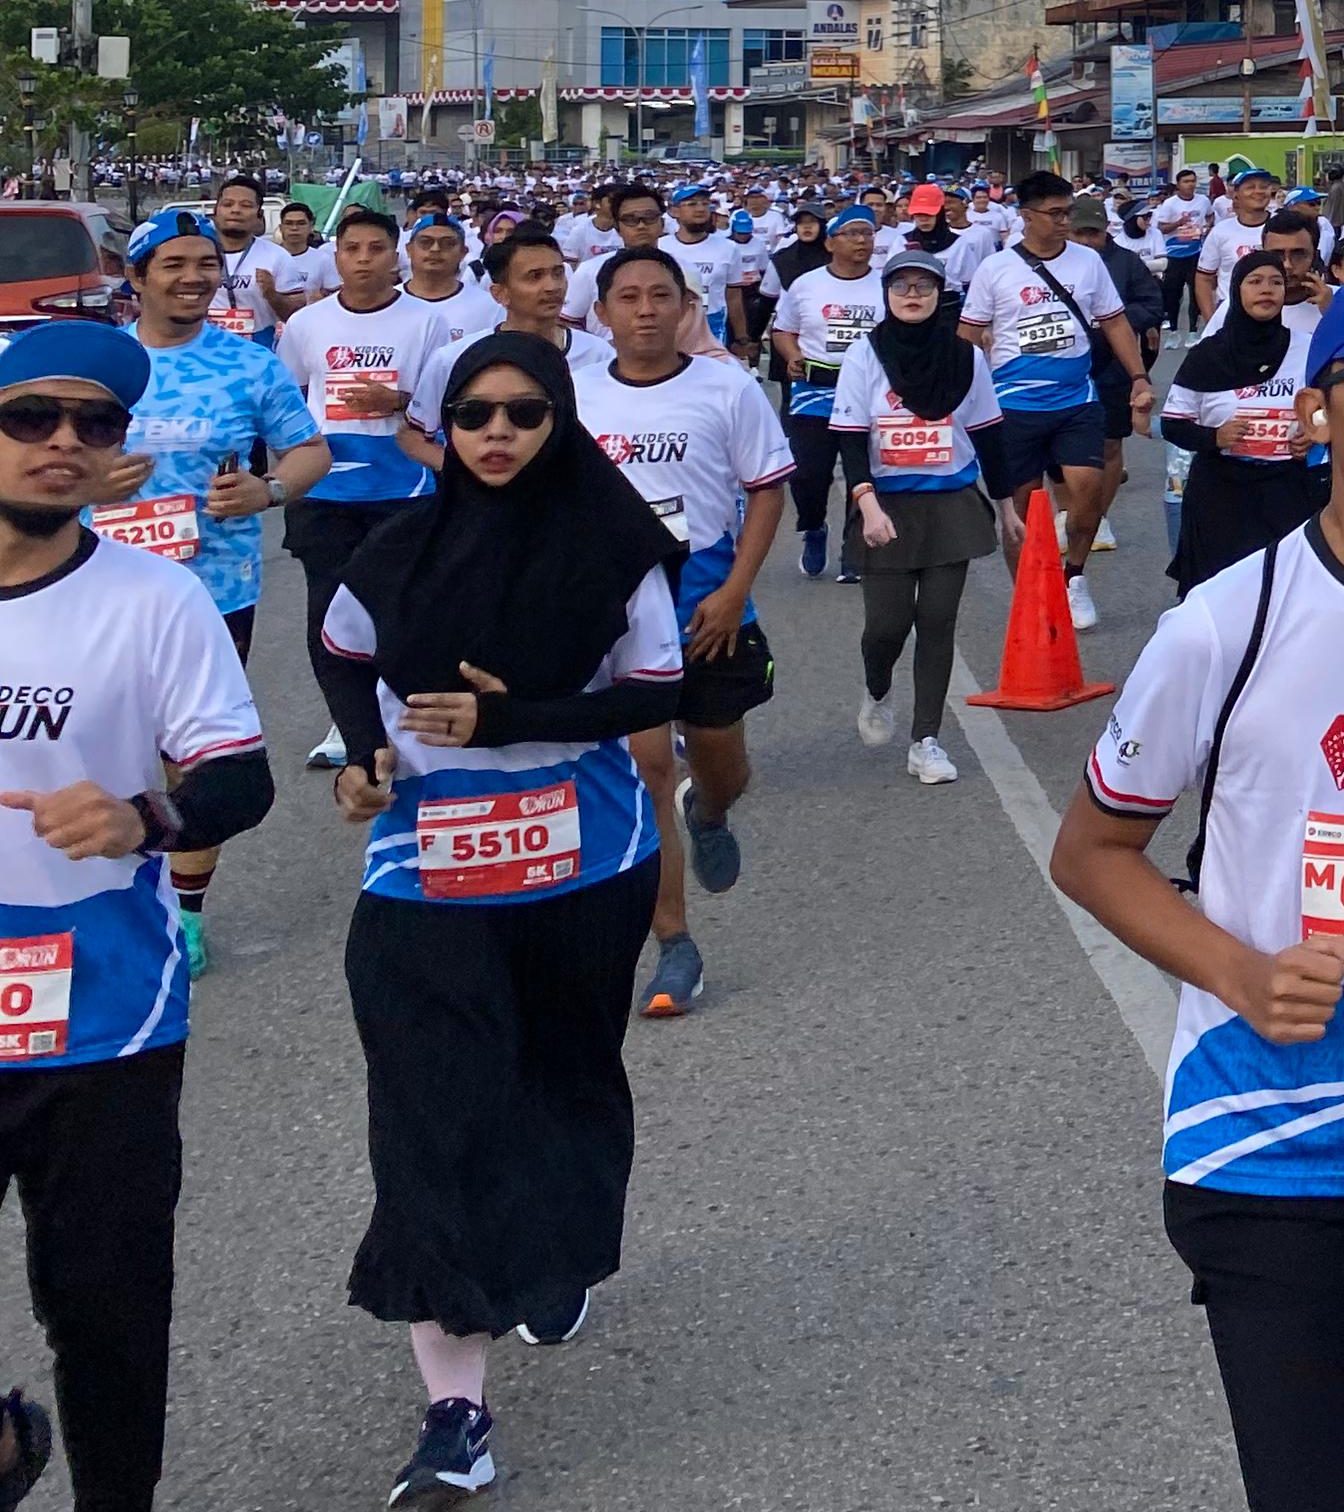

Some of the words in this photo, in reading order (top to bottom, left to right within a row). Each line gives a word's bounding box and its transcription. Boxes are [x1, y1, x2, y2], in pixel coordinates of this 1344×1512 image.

[813, 23, 859, 34] ANDALAS
[1028, 324, 1065, 341] 8375
[350, 354, 393, 368] RUN
[1256, 384, 1294, 398] RUN
[631, 433, 689, 444] KIDECO
[890, 431, 940, 448] 6094
[626, 444, 688, 465] RUN
[0, 686, 75, 705] DECO
[0, 704, 73, 742] UN
[420, 833, 436, 852] F
[451, 824, 550, 862] 5510
[1304, 863, 1335, 891] M
